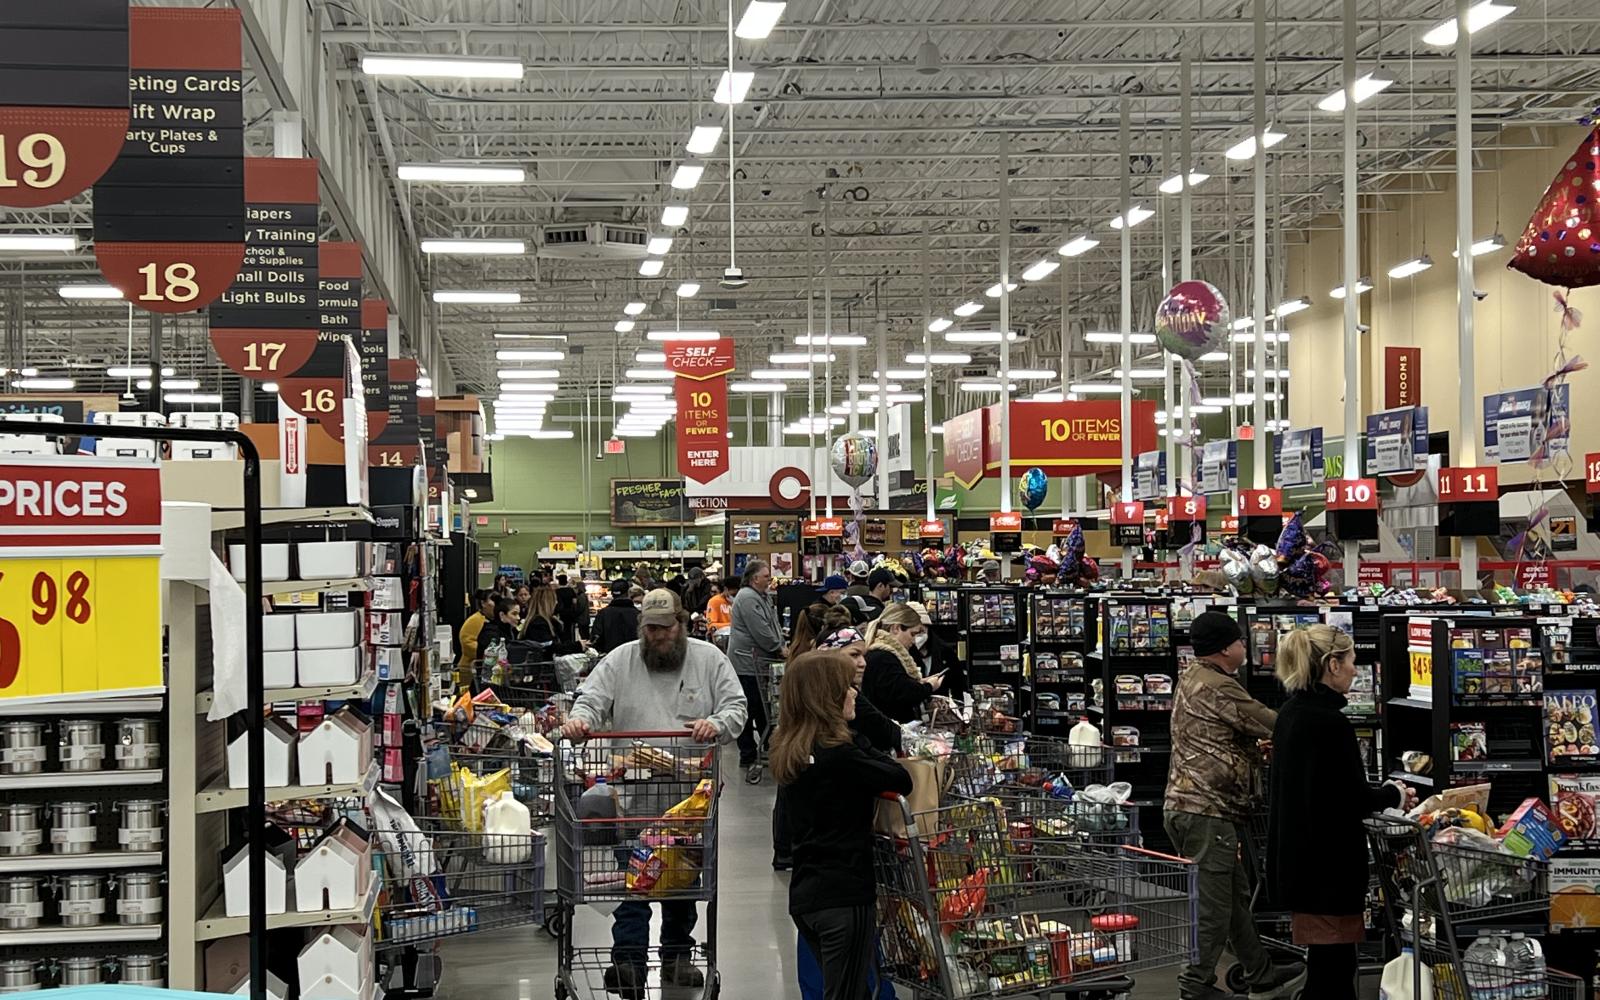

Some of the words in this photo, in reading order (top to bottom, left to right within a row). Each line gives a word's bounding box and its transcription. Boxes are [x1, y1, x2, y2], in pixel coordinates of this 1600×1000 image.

[184, 77, 241, 92] Cards
[161, 105, 216, 122] Wrap
[160, 130, 203, 142] Plates
[208, 130, 218, 141] &
[150, 142, 186, 155] Cups
[257, 228, 316, 244] Training
[278, 247, 285, 256] &
[259, 256, 304, 266] Supplies
[139, 262, 199, 304] 18
[268, 271, 305, 283] Dolls
[318, 281, 349, 290] Food
[222, 291, 260, 305] Light
[265, 291, 306, 304] Bulbs
[321, 314, 348, 324] Bath
[362, 345, 384, 353] ools
[686, 347, 717, 357] SELF
[243, 343, 286, 371] 17
[672, 357, 714, 368] CHECK
[301, 390, 336, 413] 16
[690, 392, 712, 408] 10
[685, 409, 718, 420] ITEMS
[685, 427, 719, 435] FEWER
[1041, 418, 1071, 441] 10
[1072, 419, 1120, 433] ITEMS
[1072, 433, 1086, 441] OR
[1087, 433, 1120, 441] FEWER
[380, 452, 402, 466] 14
[687, 450, 719, 459] ENTER
[691, 458, 717, 467] HERE
[616, 483, 661, 497] FRESHER
[1440, 476, 1450, 494] 11
[1463, 474, 1489, 493] 11
[0, 480, 128, 517] PRICES
[1327, 486, 1337, 503] 10
[1345, 485, 1370, 502] 10
[1184, 501, 1197, 515] 8
[1258, 494, 1271, 510] 9
[1124, 506, 1136, 519] 7
[376, 517, 400, 528] Shopping
[31, 571, 91, 625] 98
[1543, 695, 1596, 710] PALEO
